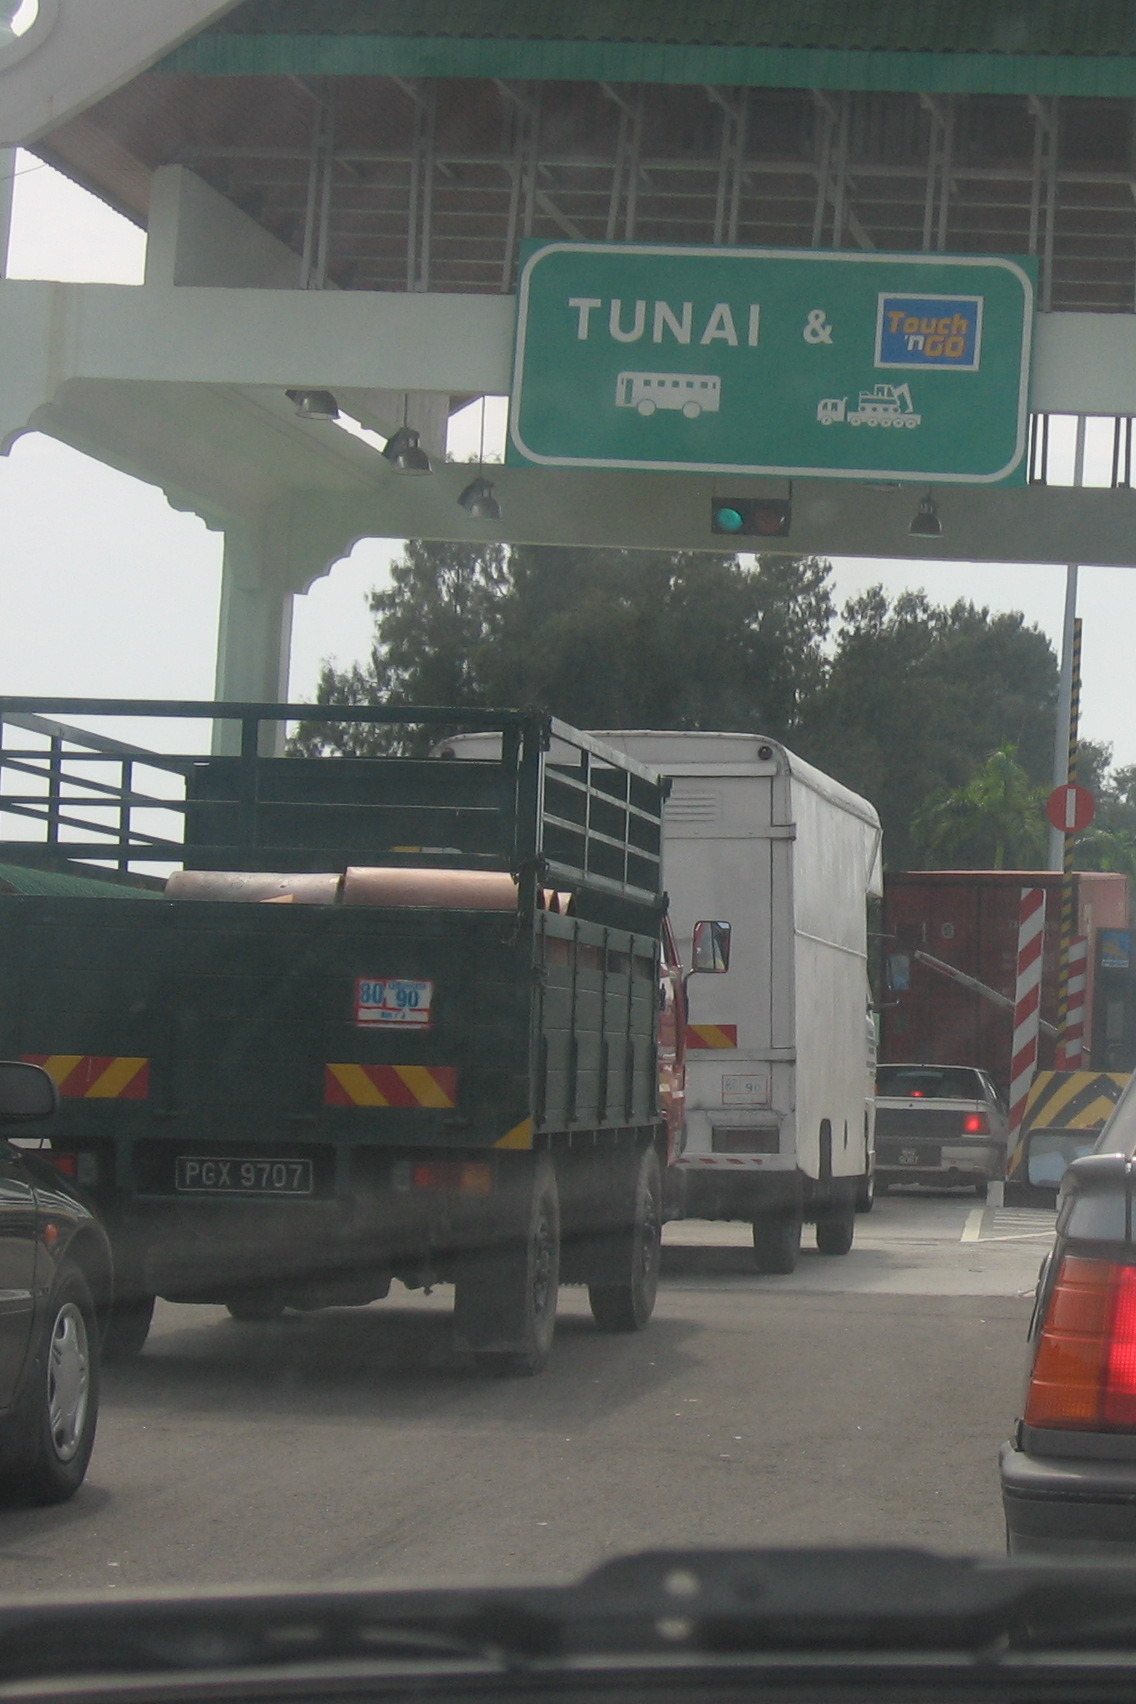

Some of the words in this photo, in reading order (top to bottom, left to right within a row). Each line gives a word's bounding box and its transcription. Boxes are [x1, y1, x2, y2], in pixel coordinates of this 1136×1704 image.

[568, 297, 760, 347] TUNAI
[803, 309, 833, 344] &
[888, 310, 970, 335] Touch
[361, 982, 384, 1004] 80
[396, 989, 420, 1008] 90
[186, 1162, 231, 1186] PGX
[241, 1163, 303, 1188] 9707
